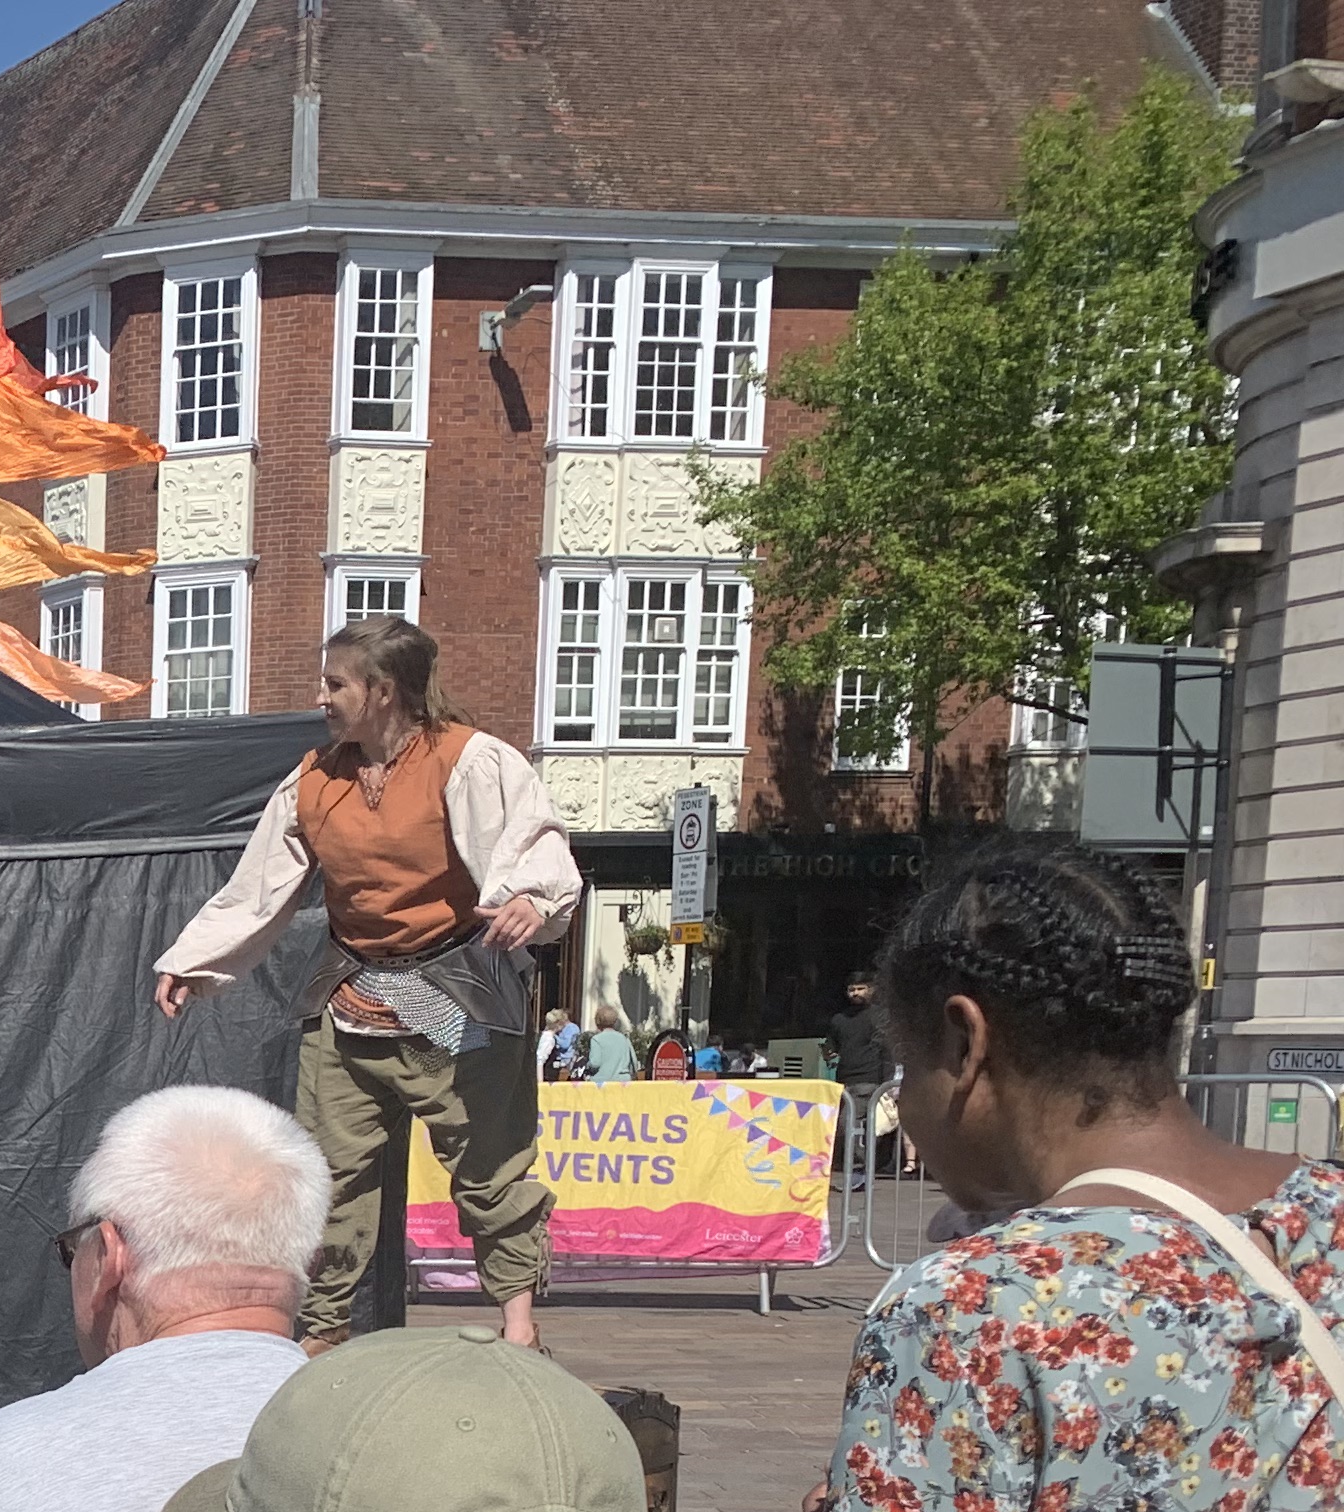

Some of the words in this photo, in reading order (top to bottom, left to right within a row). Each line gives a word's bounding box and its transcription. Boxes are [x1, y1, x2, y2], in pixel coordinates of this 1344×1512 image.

[680, 799, 703, 811] ZONE
[1274, 1052, 1289, 1068] ST
[1291, 1052, 1343, 1070] NICHOL
[525, 1151, 676, 1185] VENTS
[705, 1228, 764, 1243] Leicester
